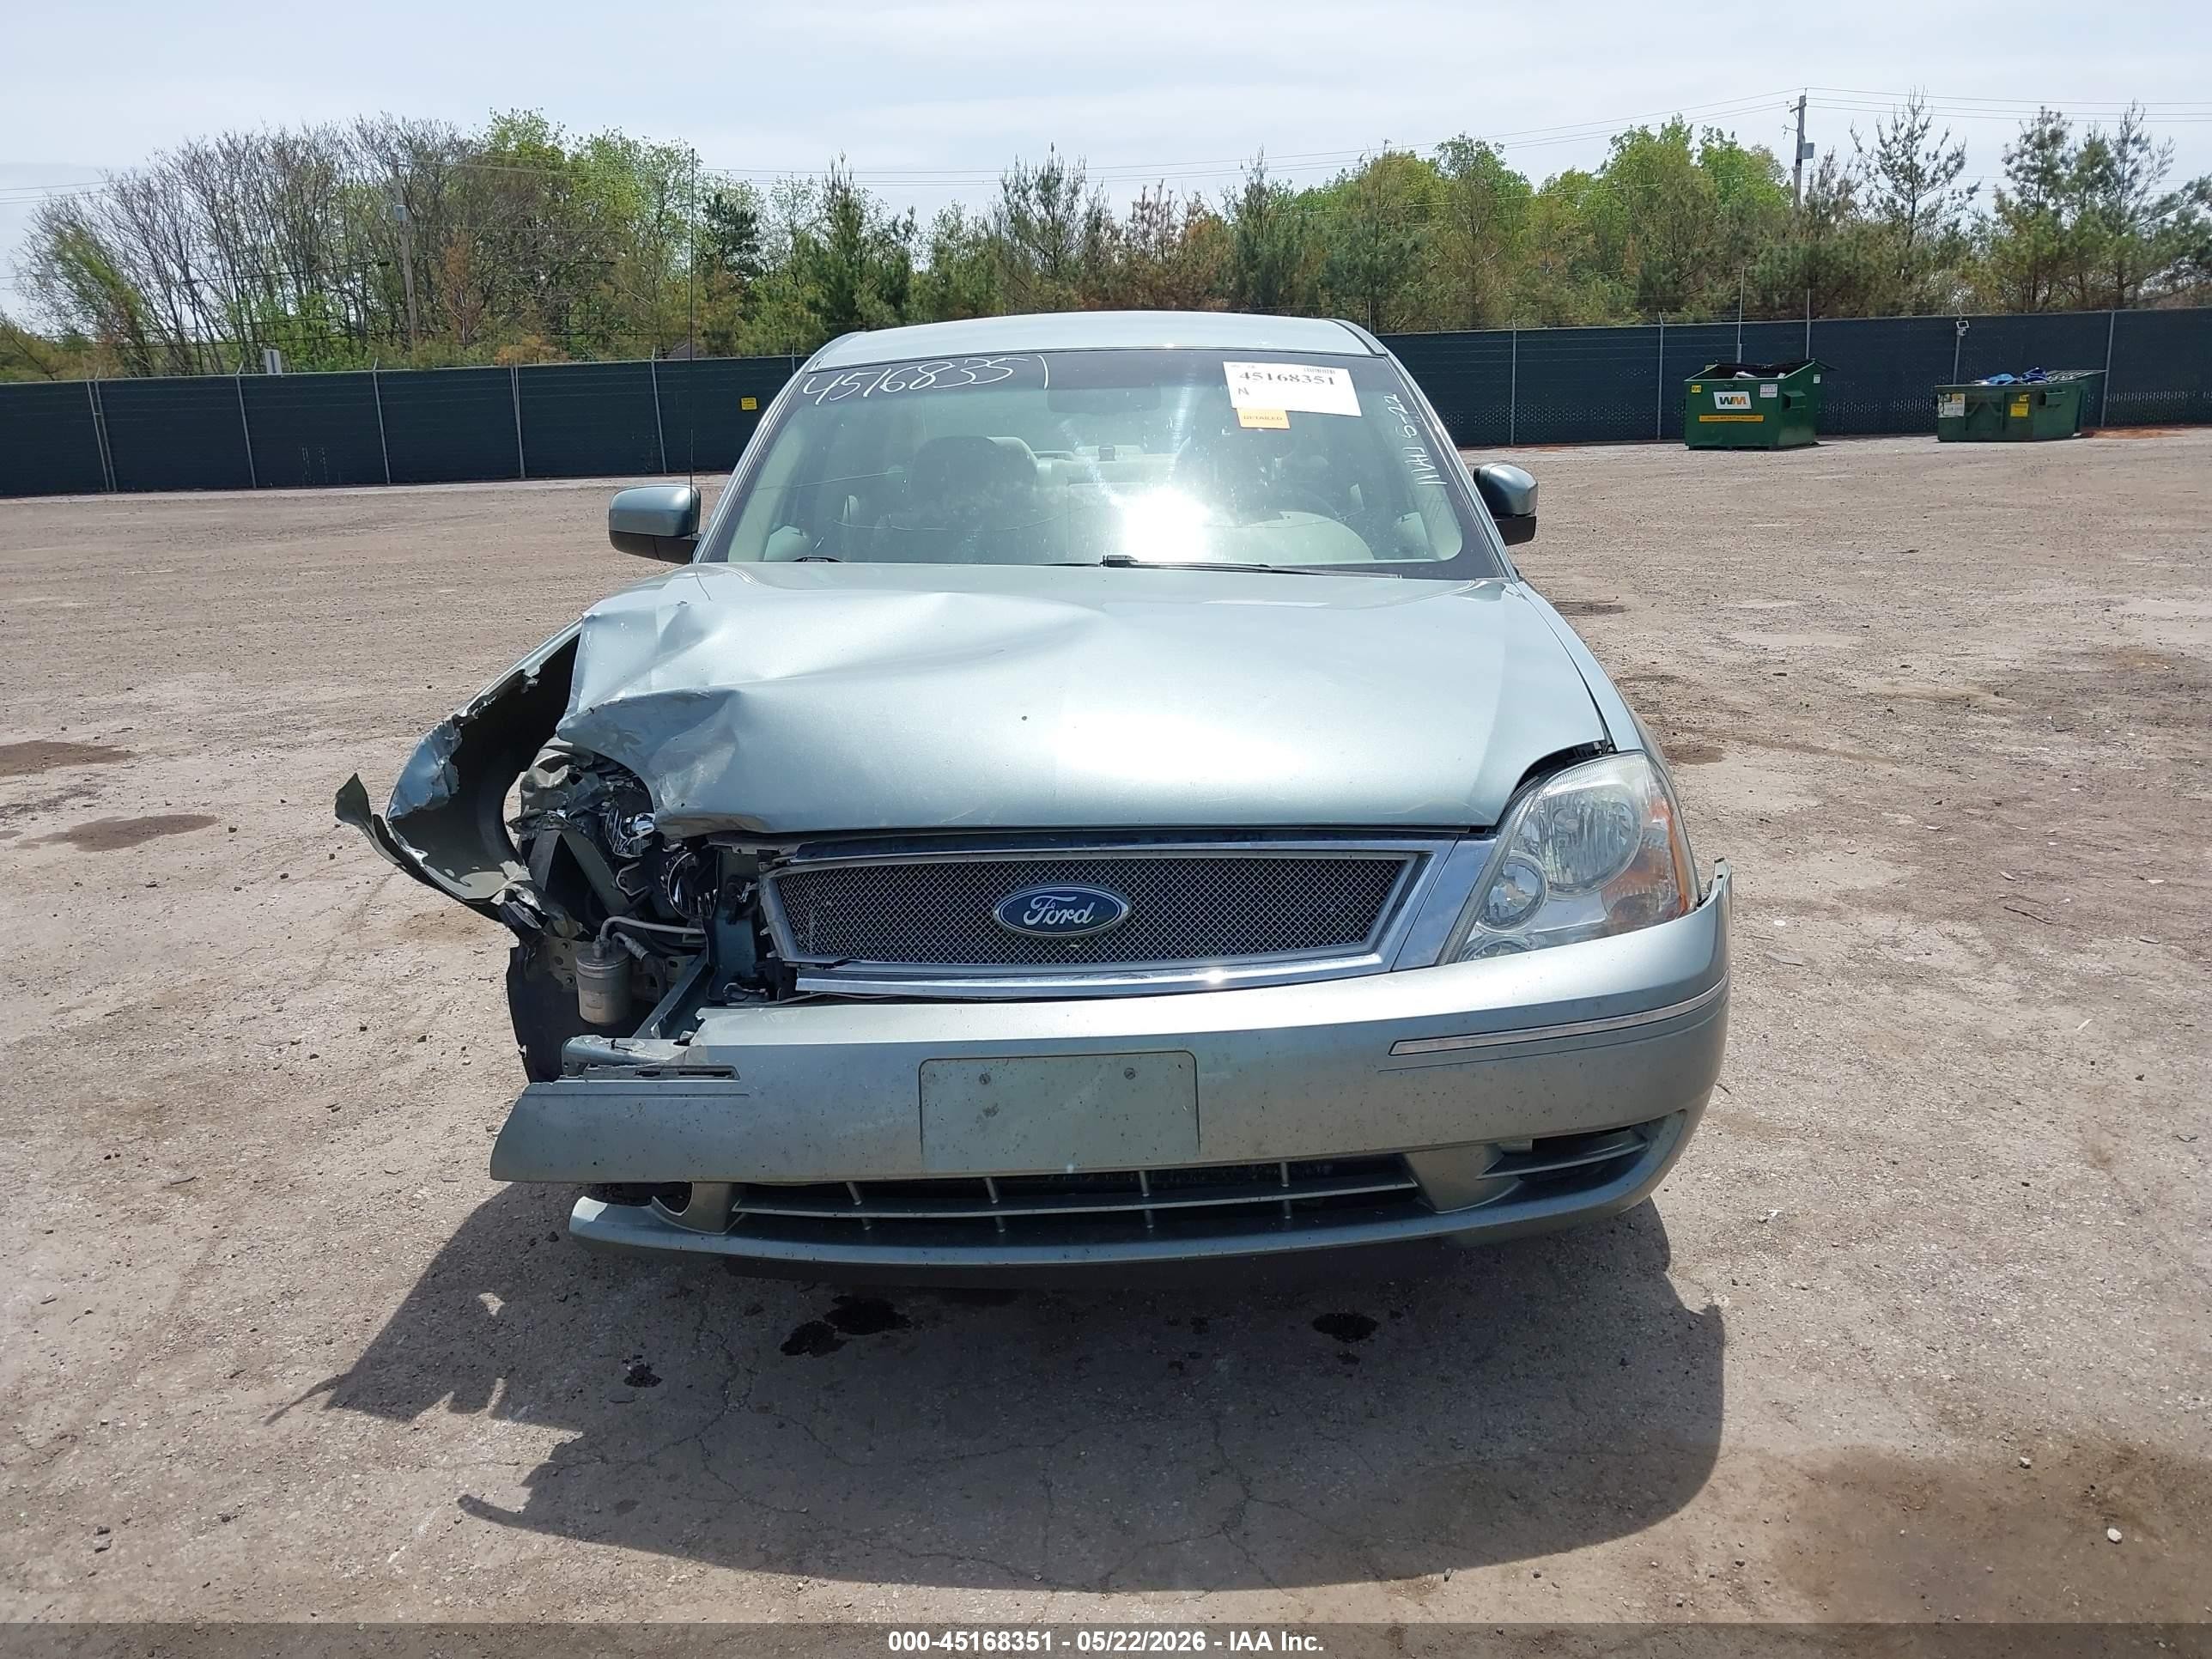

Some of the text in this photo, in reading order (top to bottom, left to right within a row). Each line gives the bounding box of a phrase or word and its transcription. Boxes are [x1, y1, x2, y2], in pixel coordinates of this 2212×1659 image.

[802, 354, 1049, 405] 45168351
[1239, 371, 1335, 386] 45168351
[1237, 386, 1250, 396] N
[1719, 396, 1747, 405] WM
[1023, 895, 1096, 926] Ford
